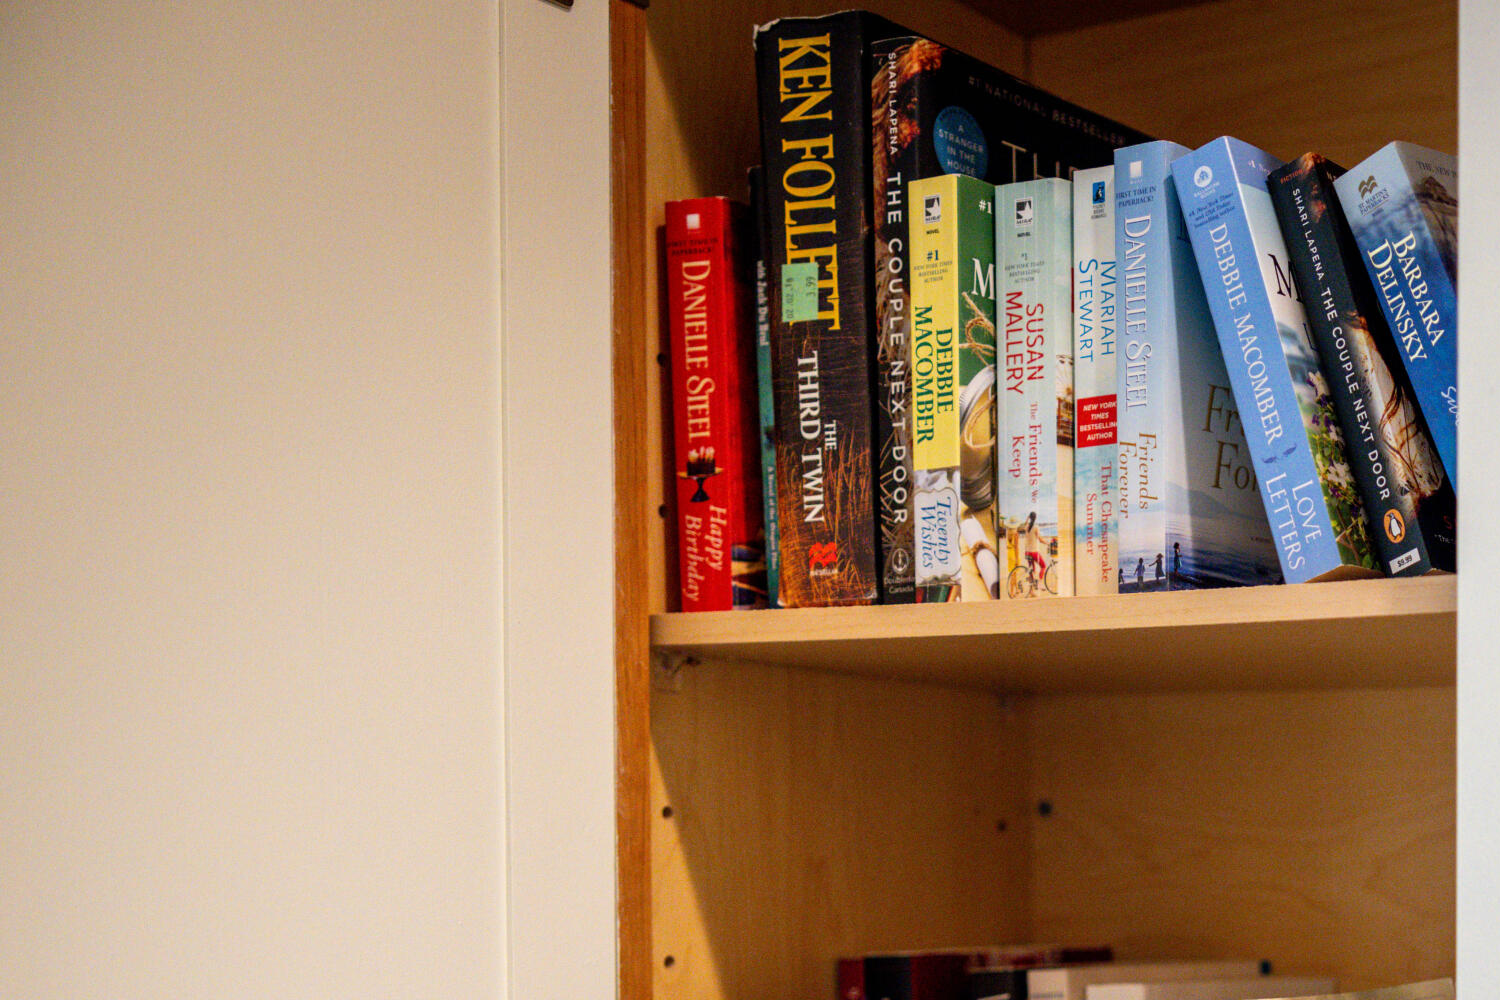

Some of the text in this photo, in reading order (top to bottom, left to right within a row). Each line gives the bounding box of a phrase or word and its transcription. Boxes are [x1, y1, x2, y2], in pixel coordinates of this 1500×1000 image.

[889, 101, 898, 155] LAPENA
[938, 129, 984, 154] STRANGER
[779, 33, 841, 331] KEN FOLLETT
[947, 159, 977, 176] HOUSE
[926, 249, 939, 261] #1
[1292, 188, 1325, 282] SHARI LAPENA
[682, 260, 711, 369] DANIELLE
[1079, 258, 1098, 362] STEWART
[1100, 260, 1117, 357] MARIAH
[1124, 214, 1152, 410] DANIELLE STEEL
[1367, 239, 1428, 363] DELINSKY
[1391, 231, 1445, 346] BARBARA
[886, 173, 907, 523] THE COUPLE NEXT DOOR
[936, 328, 954, 414] DEBBIE
[1005, 291, 1024, 395] MALLERY
[1026, 303, 1044, 381] SUSAN
[1209, 223, 1248, 310] DEBBIE
[1234, 313, 1284, 445] MACOMBER
[685, 372, 715, 441] STEEL
[914, 306, 936, 445] MACOMBER
[1029, 401, 1038, 421] The
[1083, 402, 1098, 412] NEW
[1320, 287, 1390, 501] THE COUPLE NEXT DOOR
[797, 350, 825, 524] THIRD TWIN
[823, 419, 838, 451] THE
[1028, 424, 1043, 487] Friends
[1086, 431, 1114, 441] AUTHOR
[1090, 412, 1110, 421] TIMES
[1008, 436, 1025, 478] Keep
[1119, 441, 1138, 518] Forever
[1138, 432, 1158, 510] Friends
[704, 505, 727, 571] Happy
[919, 503, 935, 570] Wishes
[935, 496, 952, 566] Twenty
[1086, 493, 1098, 556] Summer
[1100, 461, 1113, 584] That Chesapeake
[1265, 472, 1306, 570] LETTERS
[1291, 479, 1322, 545] LOVE
[684, 515, 705, 602] Birthday
